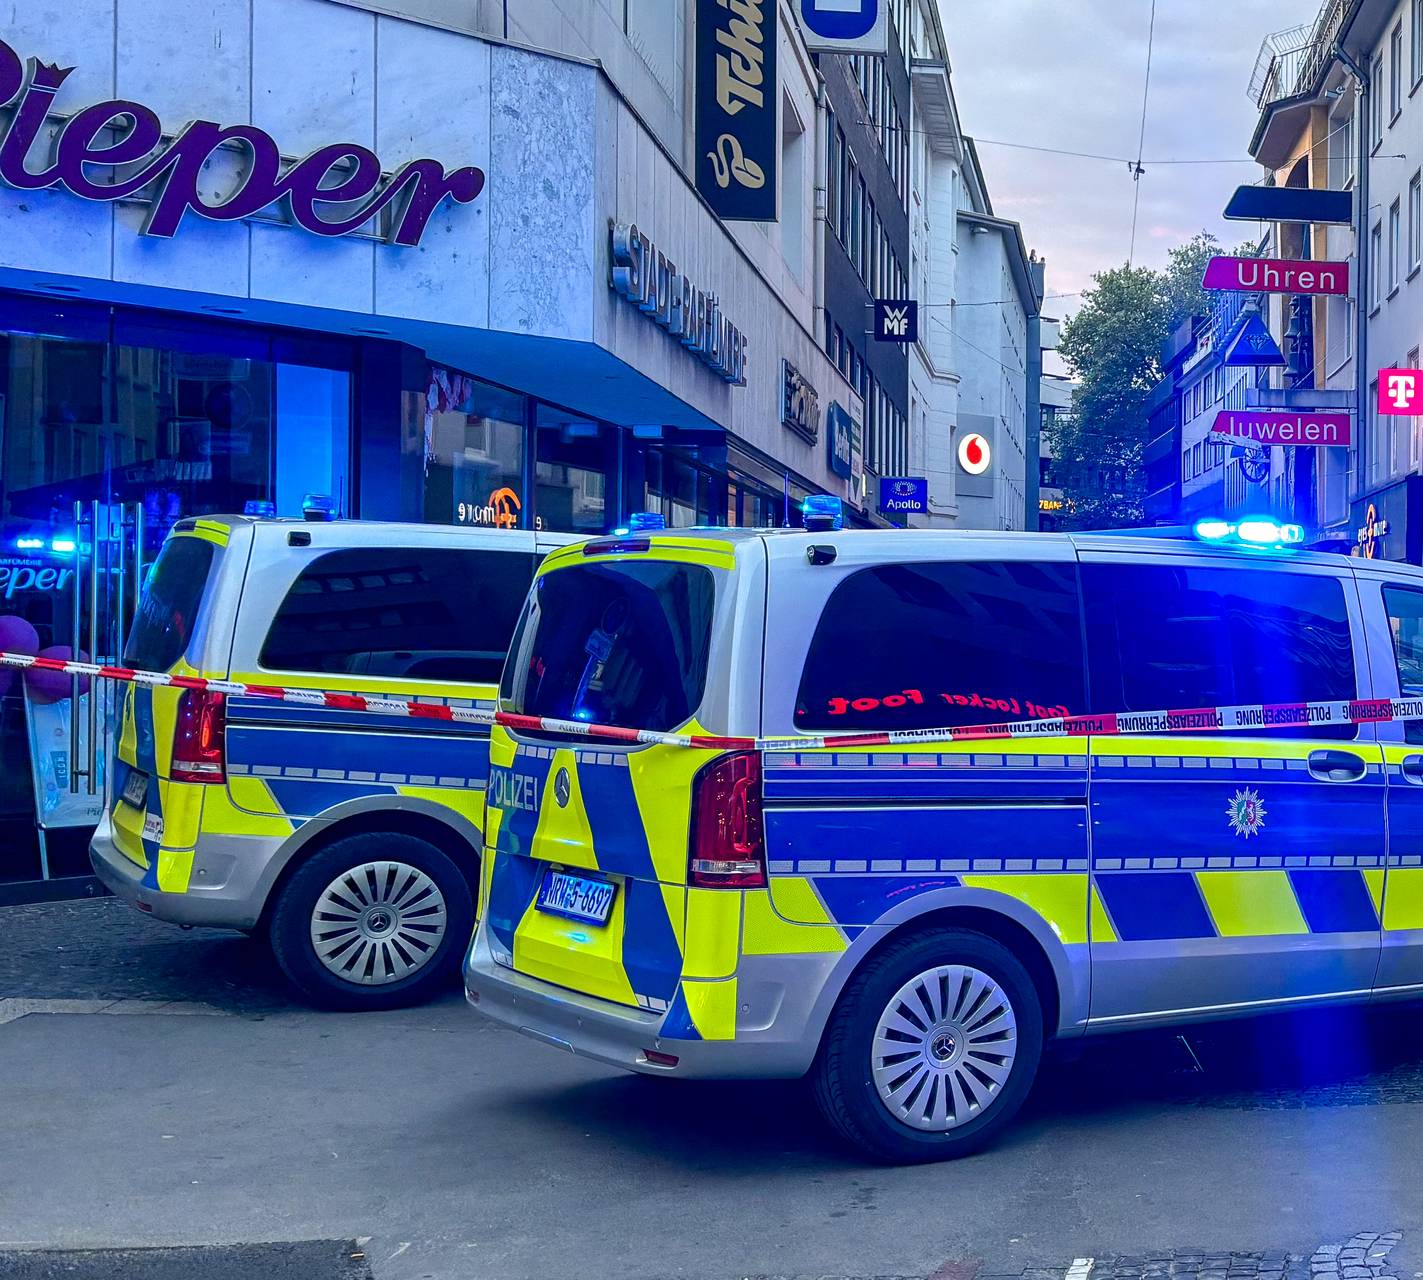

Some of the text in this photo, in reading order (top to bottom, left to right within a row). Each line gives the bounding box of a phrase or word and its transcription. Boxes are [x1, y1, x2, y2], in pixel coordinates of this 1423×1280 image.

[716, 0, 764, 116] Tchi
[1237, 262, 1336, 291] Uhren
[883, 304, 909, 336] WMF
[886, 498, 921, 510] Apollo
[1116, 709, 1224, 732] POLIZEIABSPERRUNG
[1235, 704, 1332, 727] POLIZEIABSPERRUNG
[489, 768, 538, 812] POLIZEI
[570, 878, 613, 917] 5-6697
